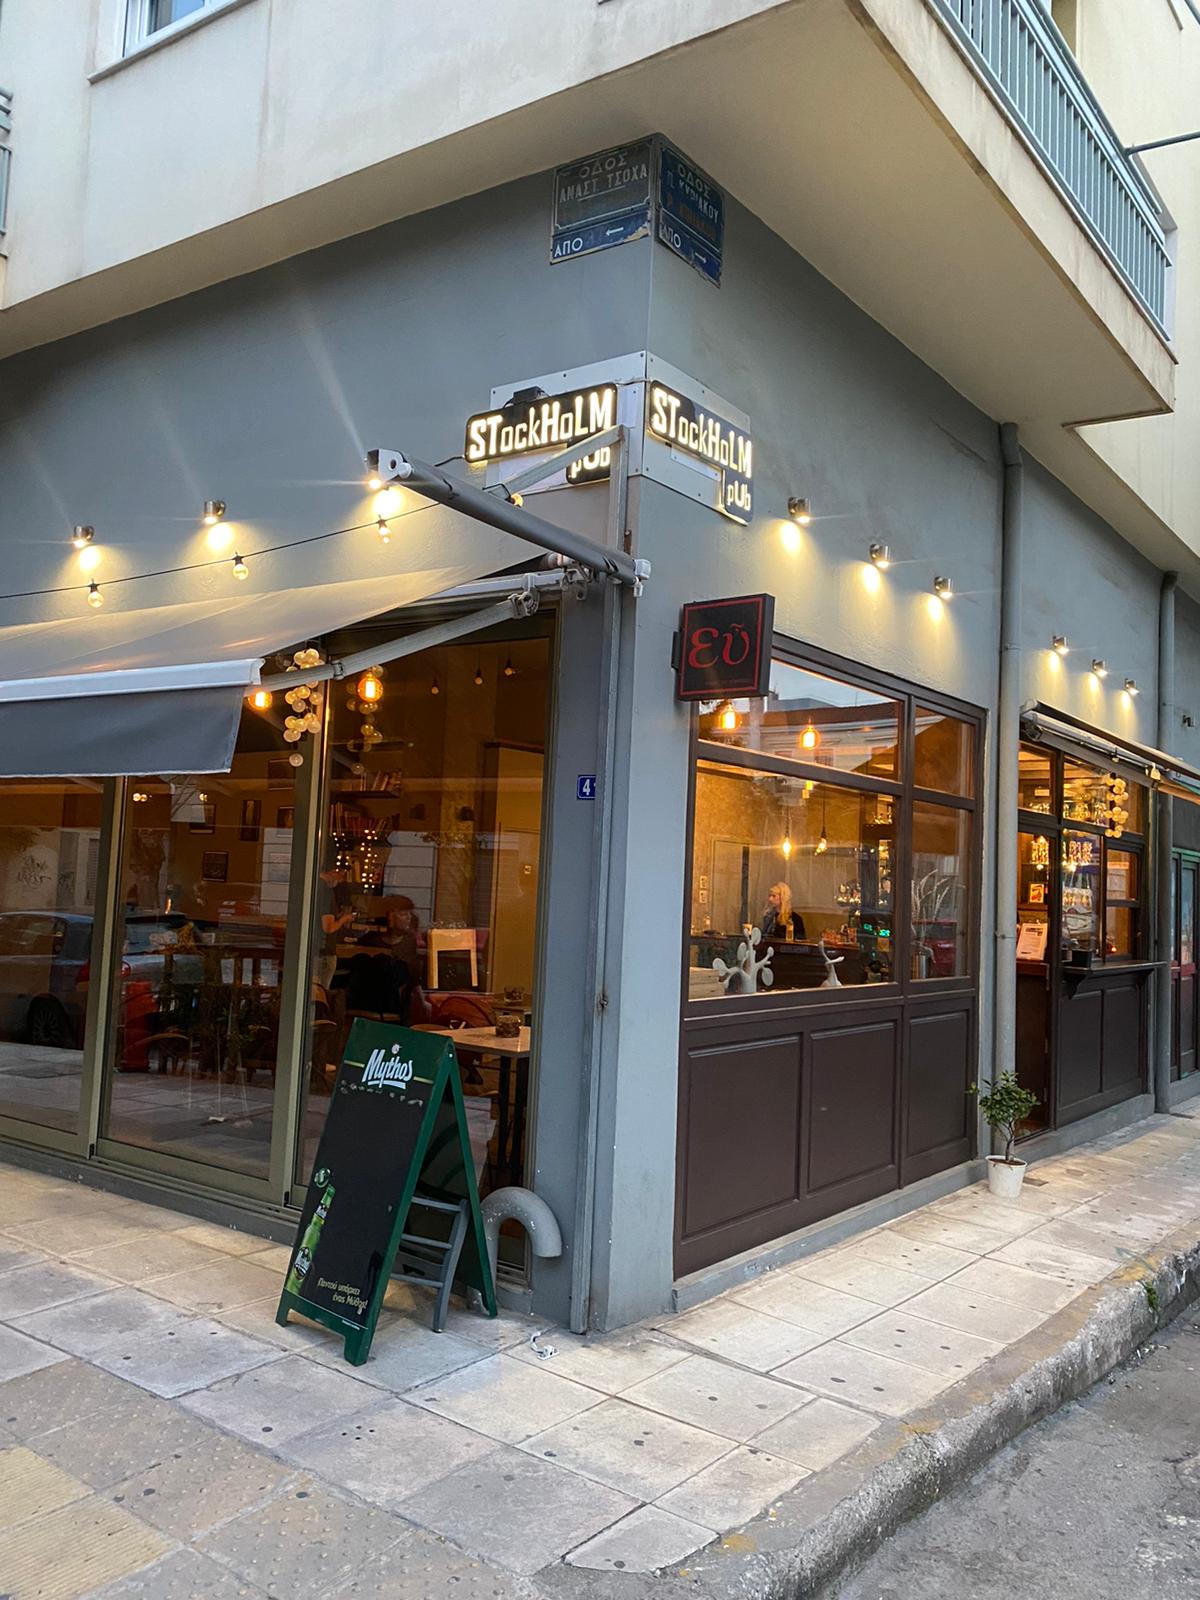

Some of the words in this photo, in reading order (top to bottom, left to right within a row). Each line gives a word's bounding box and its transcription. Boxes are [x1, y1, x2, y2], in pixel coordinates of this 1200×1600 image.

[579, 152, 629, 178] ΟΔΟΣ
[608, 163, 648, 188] ΤΣΟΧΑ
[677, 164, 711, 199] ΟΔΟΣ
[554, 237, 583, 258] ΑΠΟ
[662, 223, 681, 248] ΑΠΟ
[582, 779, 591, 796] 4
[361, 1048, 413, 1089] Mythos
